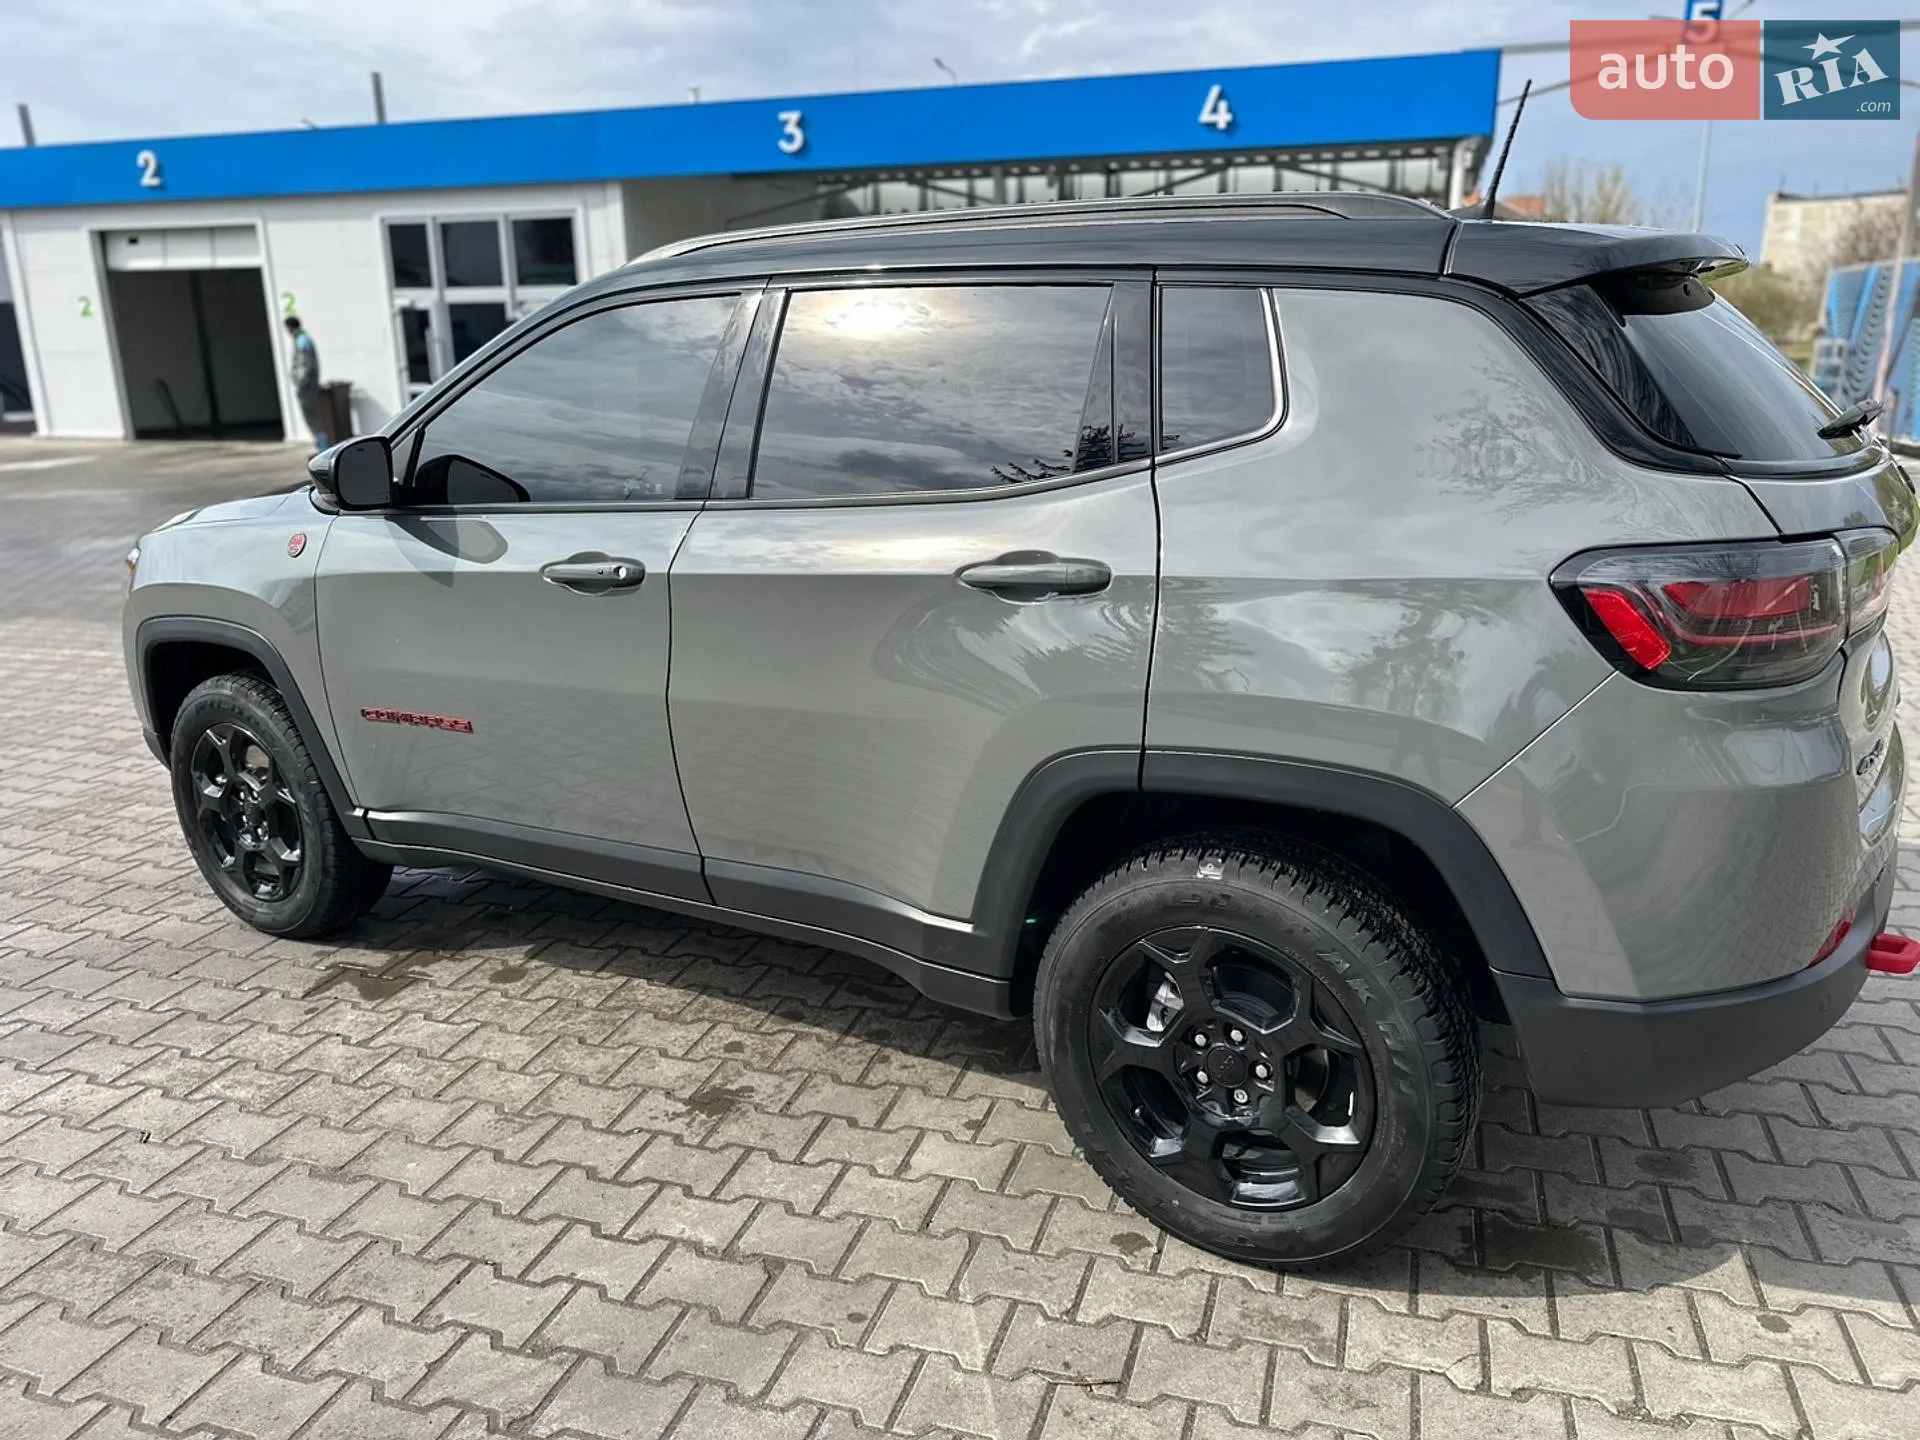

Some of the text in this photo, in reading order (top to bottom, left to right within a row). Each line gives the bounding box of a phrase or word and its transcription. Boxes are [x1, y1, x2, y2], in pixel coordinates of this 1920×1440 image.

[1685, 2, 1720, 43] 5
[1197, 84, 1233, 130] 4
[777, 110, 804, 153] 3
[136, 149, 161, 187] 2
[78, 295, 94, 318] 2
[281, 291, 297, 317] 2
